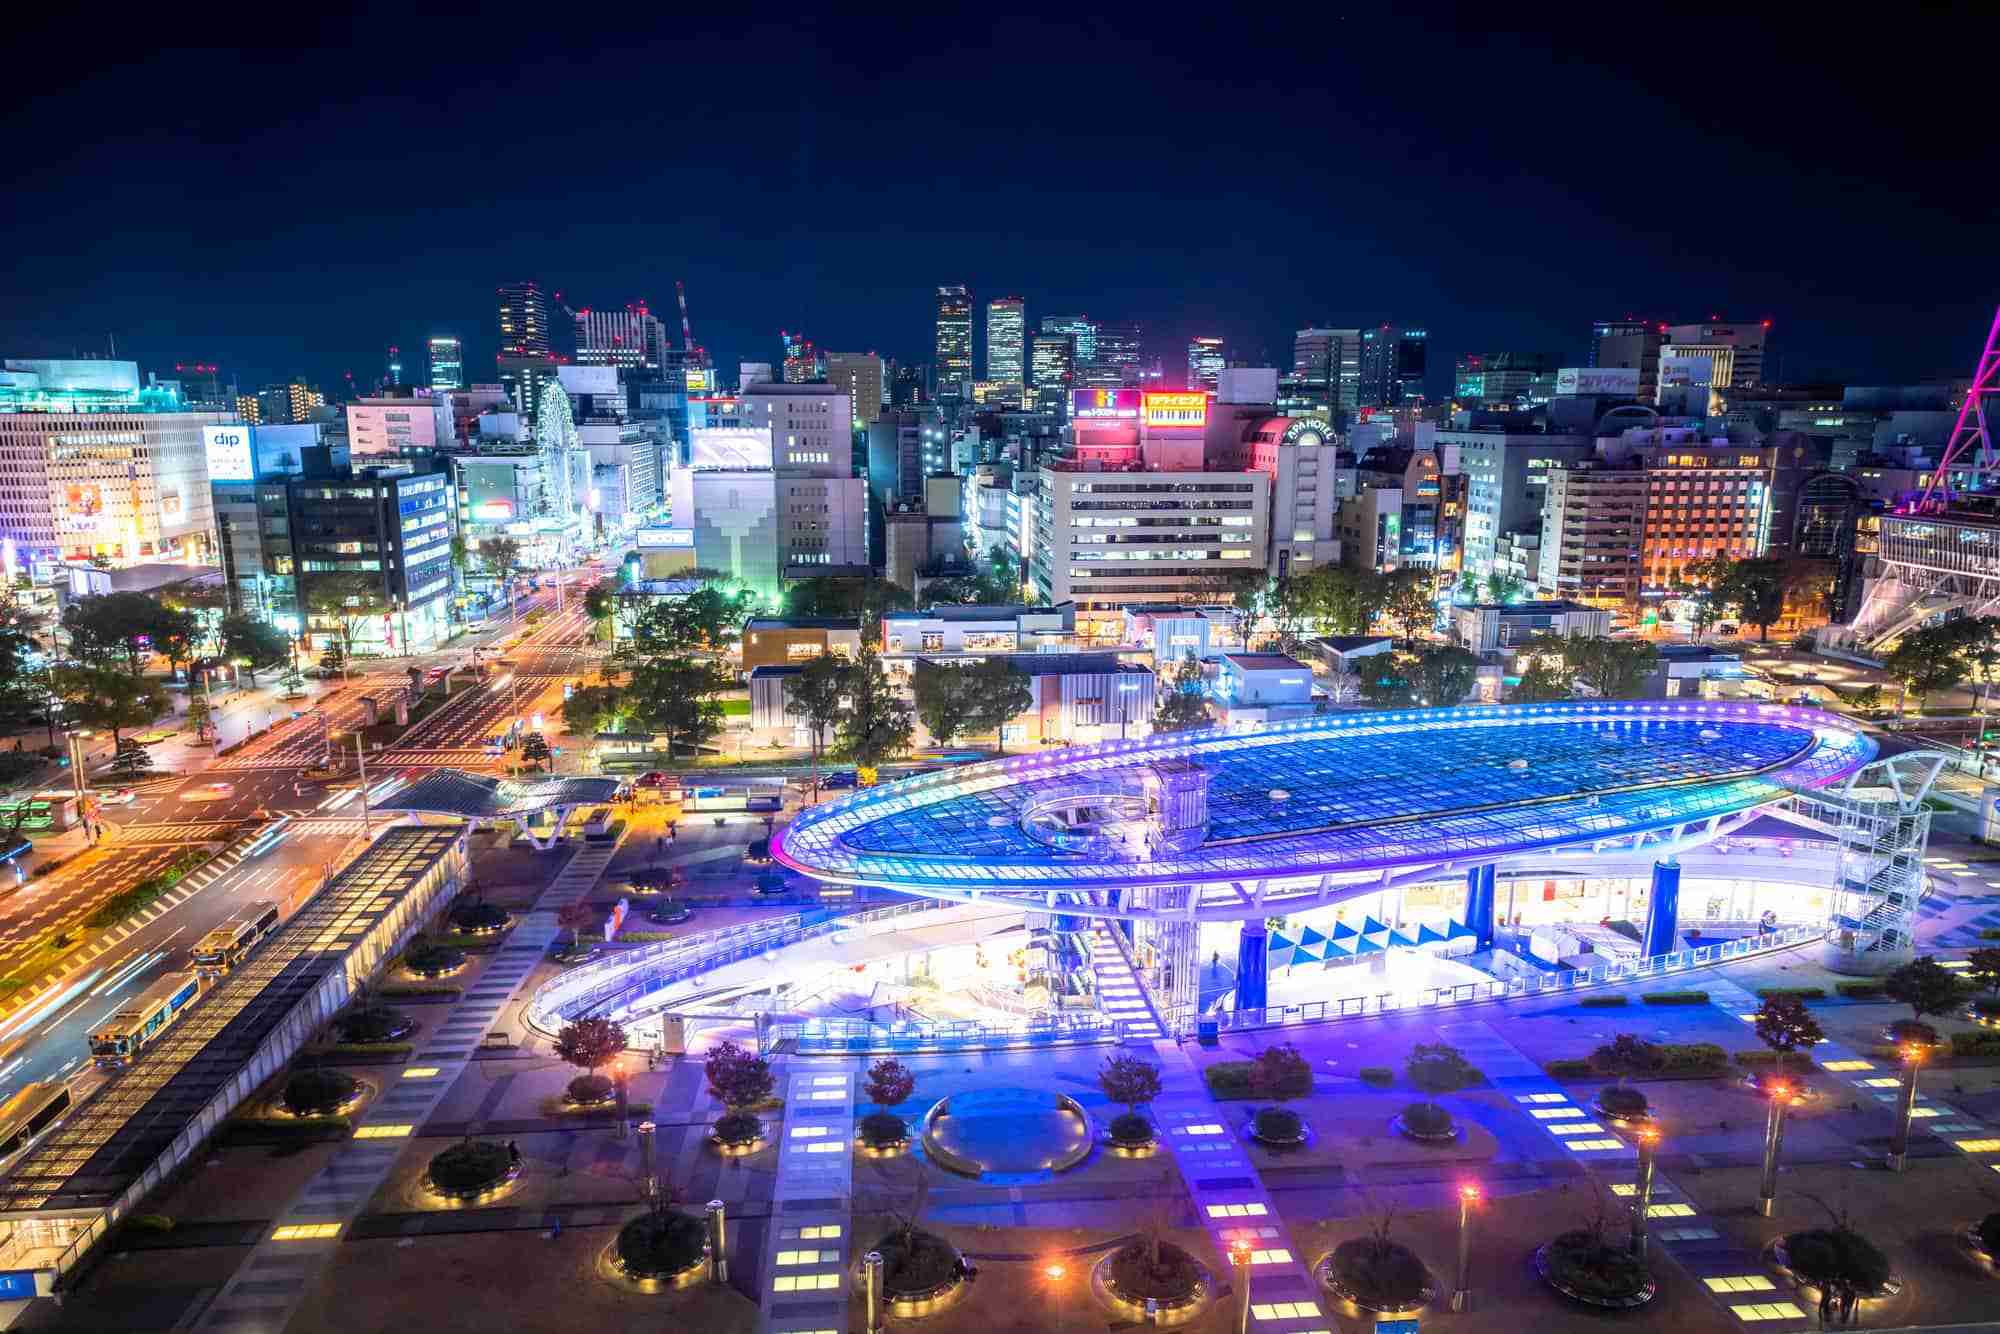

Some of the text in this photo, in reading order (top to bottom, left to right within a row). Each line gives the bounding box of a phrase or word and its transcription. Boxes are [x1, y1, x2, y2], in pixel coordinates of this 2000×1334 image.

[1288, 419, 1337, 440] APA HOTEL
[214, 432, 240, 447] dip
